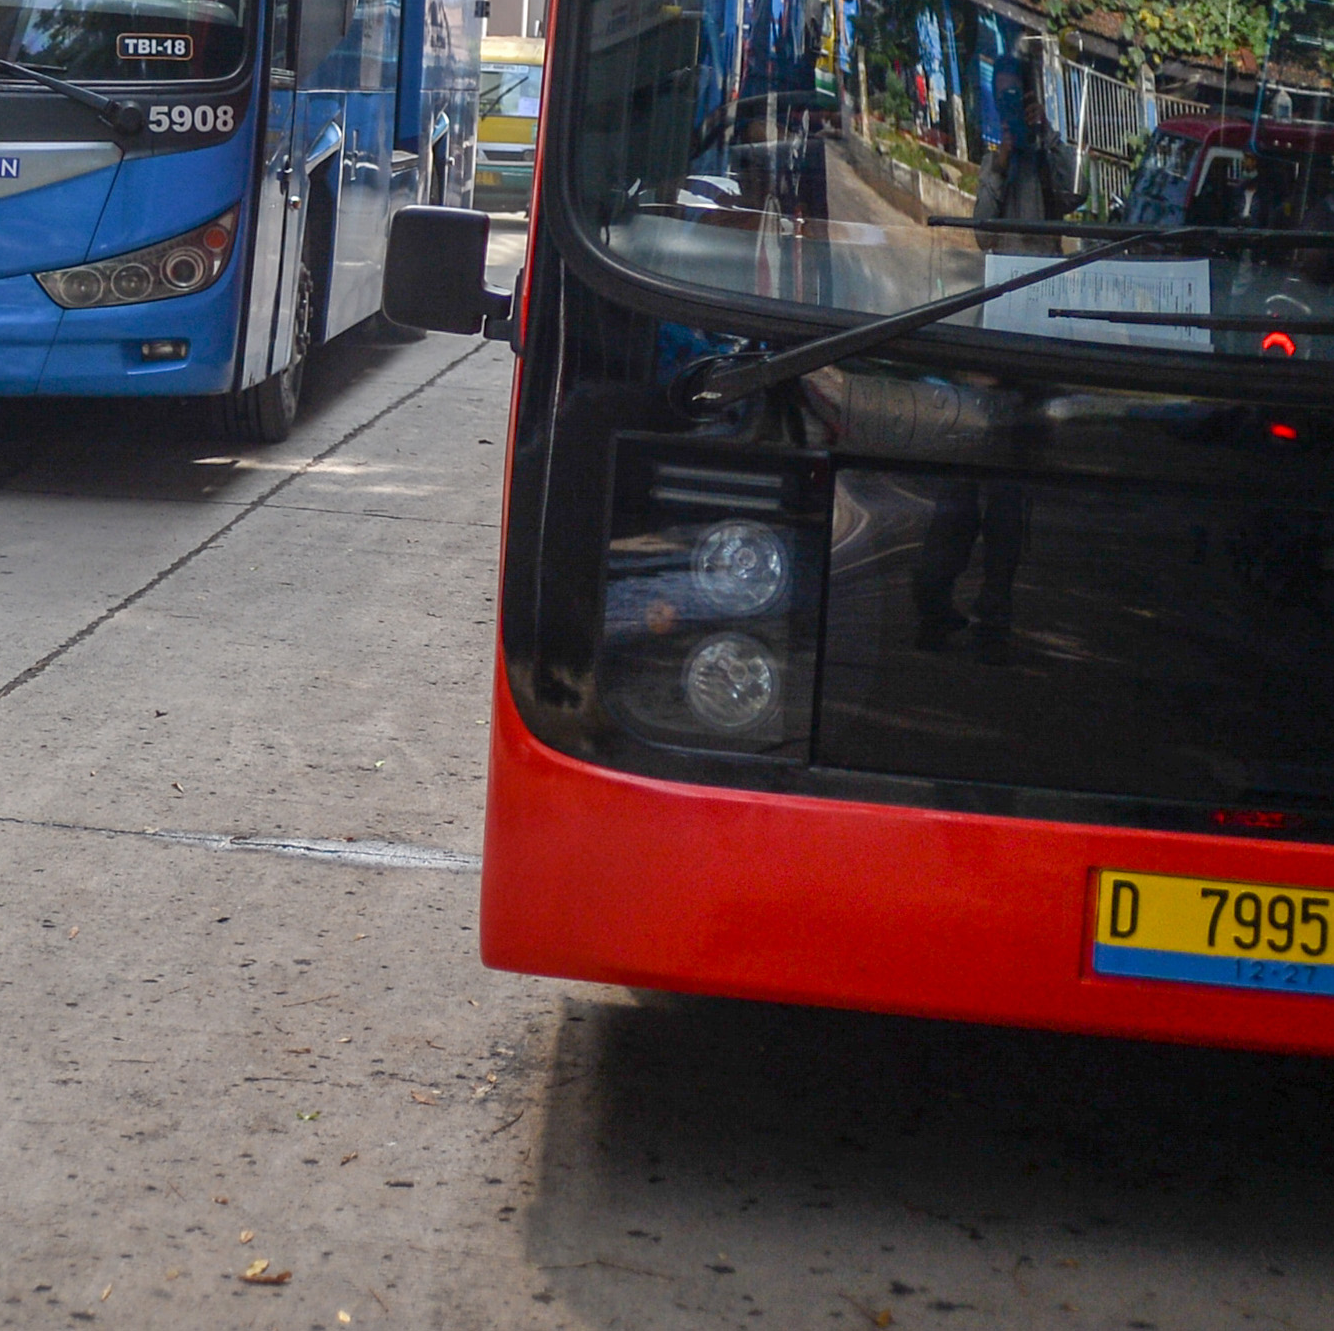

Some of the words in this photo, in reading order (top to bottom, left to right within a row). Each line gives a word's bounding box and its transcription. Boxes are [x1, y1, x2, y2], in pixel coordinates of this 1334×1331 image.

[125, 38, 186, 56] TBI-18
[148, 105, 235, 133] 5908
[1110, 879, 1139, 938] D
[1201, 888, 1330, 957] 7995
